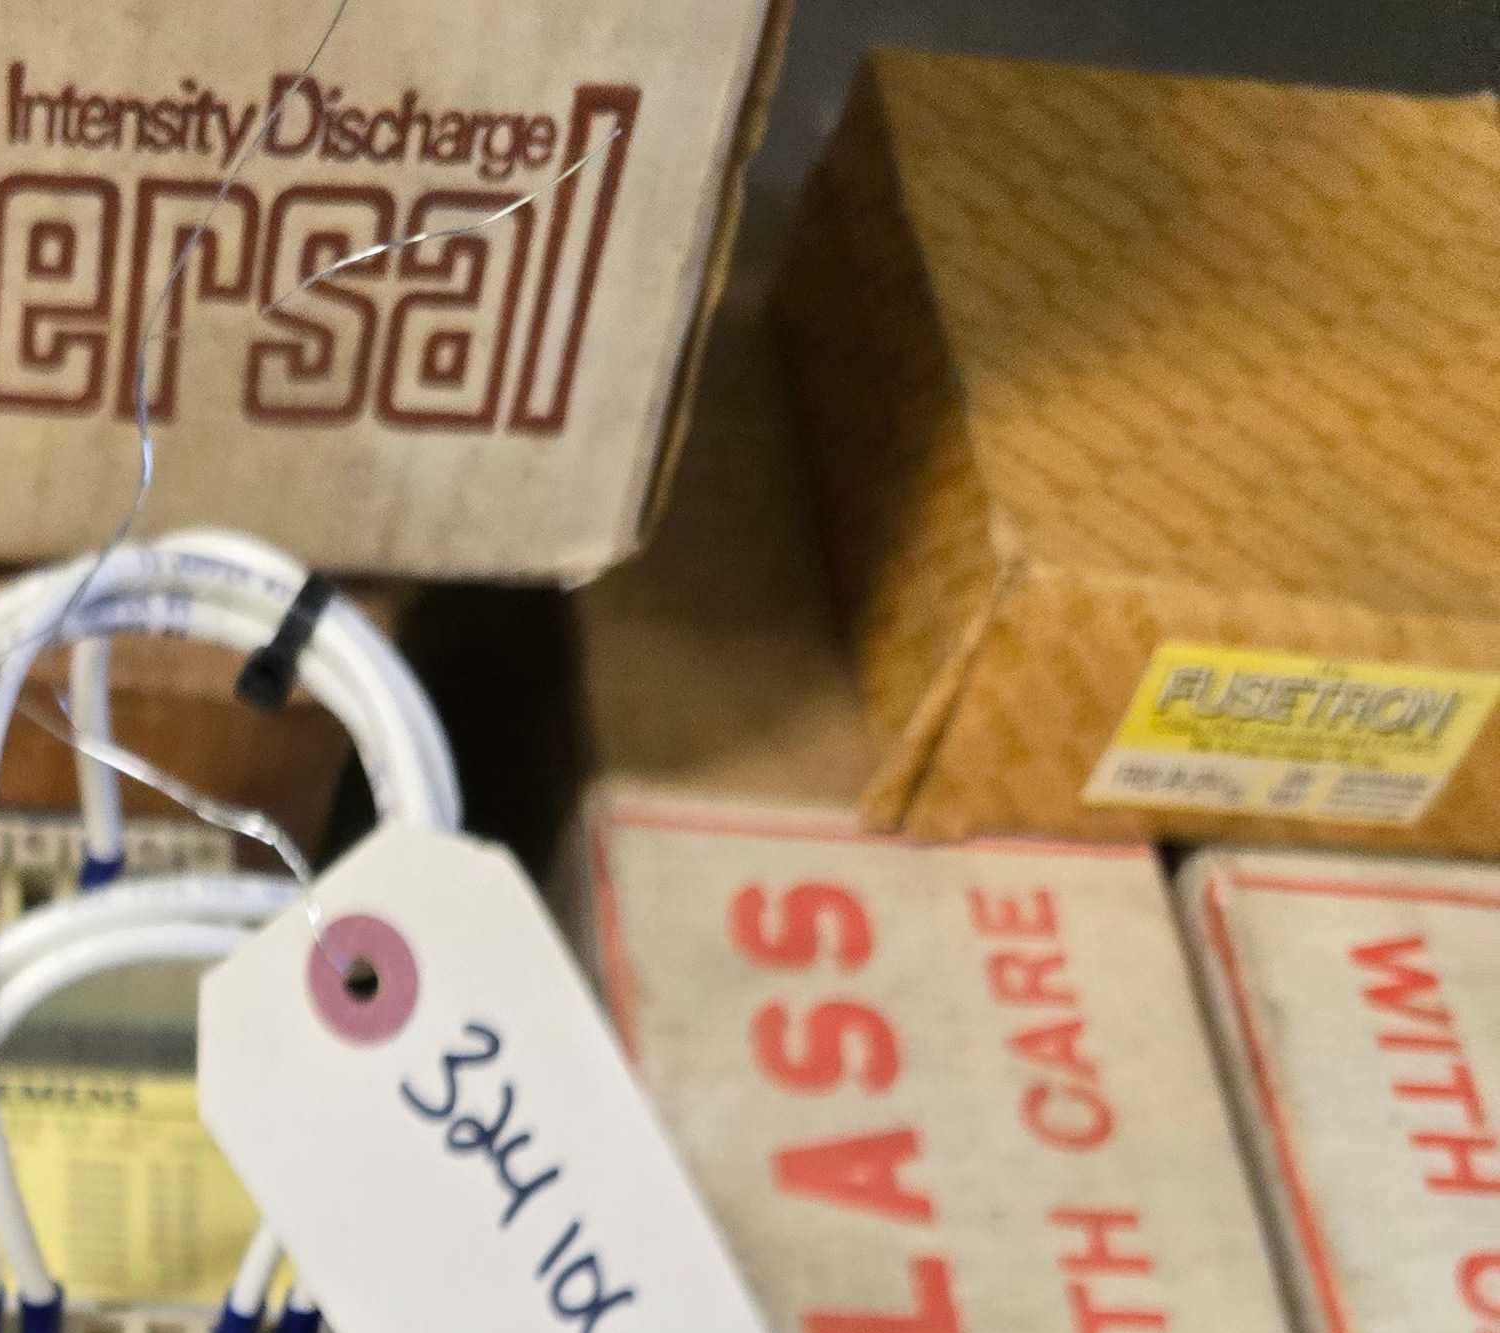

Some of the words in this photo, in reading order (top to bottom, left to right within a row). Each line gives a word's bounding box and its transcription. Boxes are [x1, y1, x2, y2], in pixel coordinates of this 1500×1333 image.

[7, 60, 257, 168] Intensity
[262, 72, 557, 179] Discharge
[400, 1023, 560, 1231] 324
[969, 884, 1117, 1153] CARE
[1349, 933, 1500, 1195] WITH
